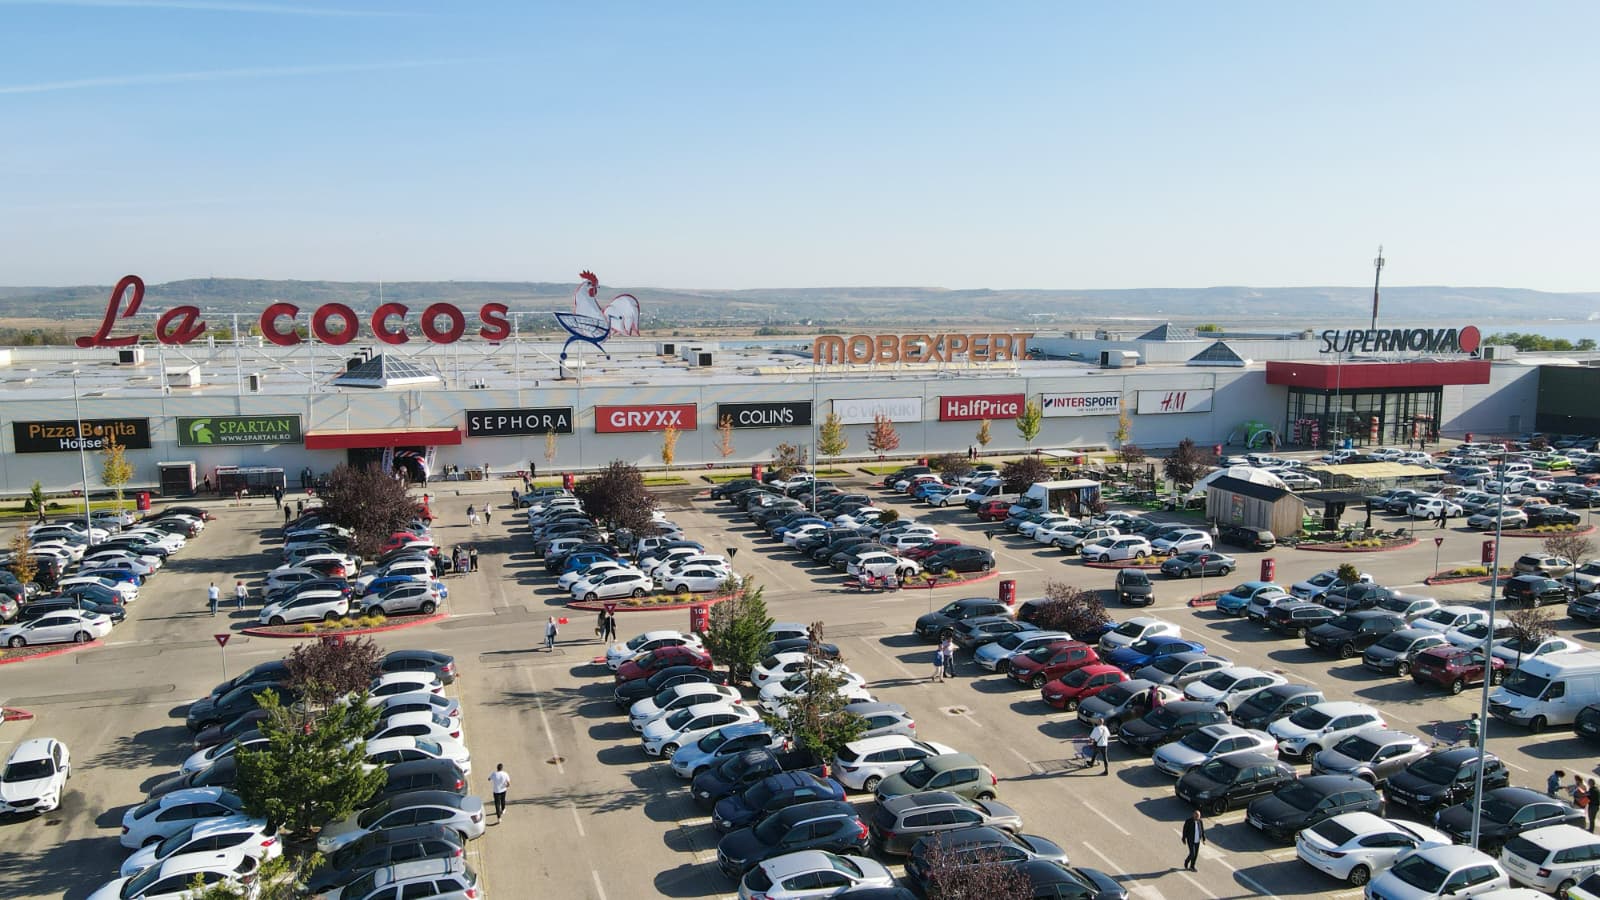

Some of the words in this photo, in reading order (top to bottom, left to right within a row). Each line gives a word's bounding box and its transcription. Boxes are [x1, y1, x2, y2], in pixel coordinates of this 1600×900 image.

[75, 274, 206, 348] La
[813, 332, 1034, 364] MOBEXPERT
[1319, 328, 1458, 353] SUPERNOVA
[947, 400, 1018, 417] HalfPrice
[1053, 396, 1120, 407] INTERSPORT
[471, 414, 567, 430] SEPHORA
[610, 410, 682, 427] GRYXX
[739, 407, 794, 425] COLIN'S
[28, 424, 76, 439] Pizza
[81, 422, 136, 437] Bonita
[219, 420, 290, 434] SPARTAN
